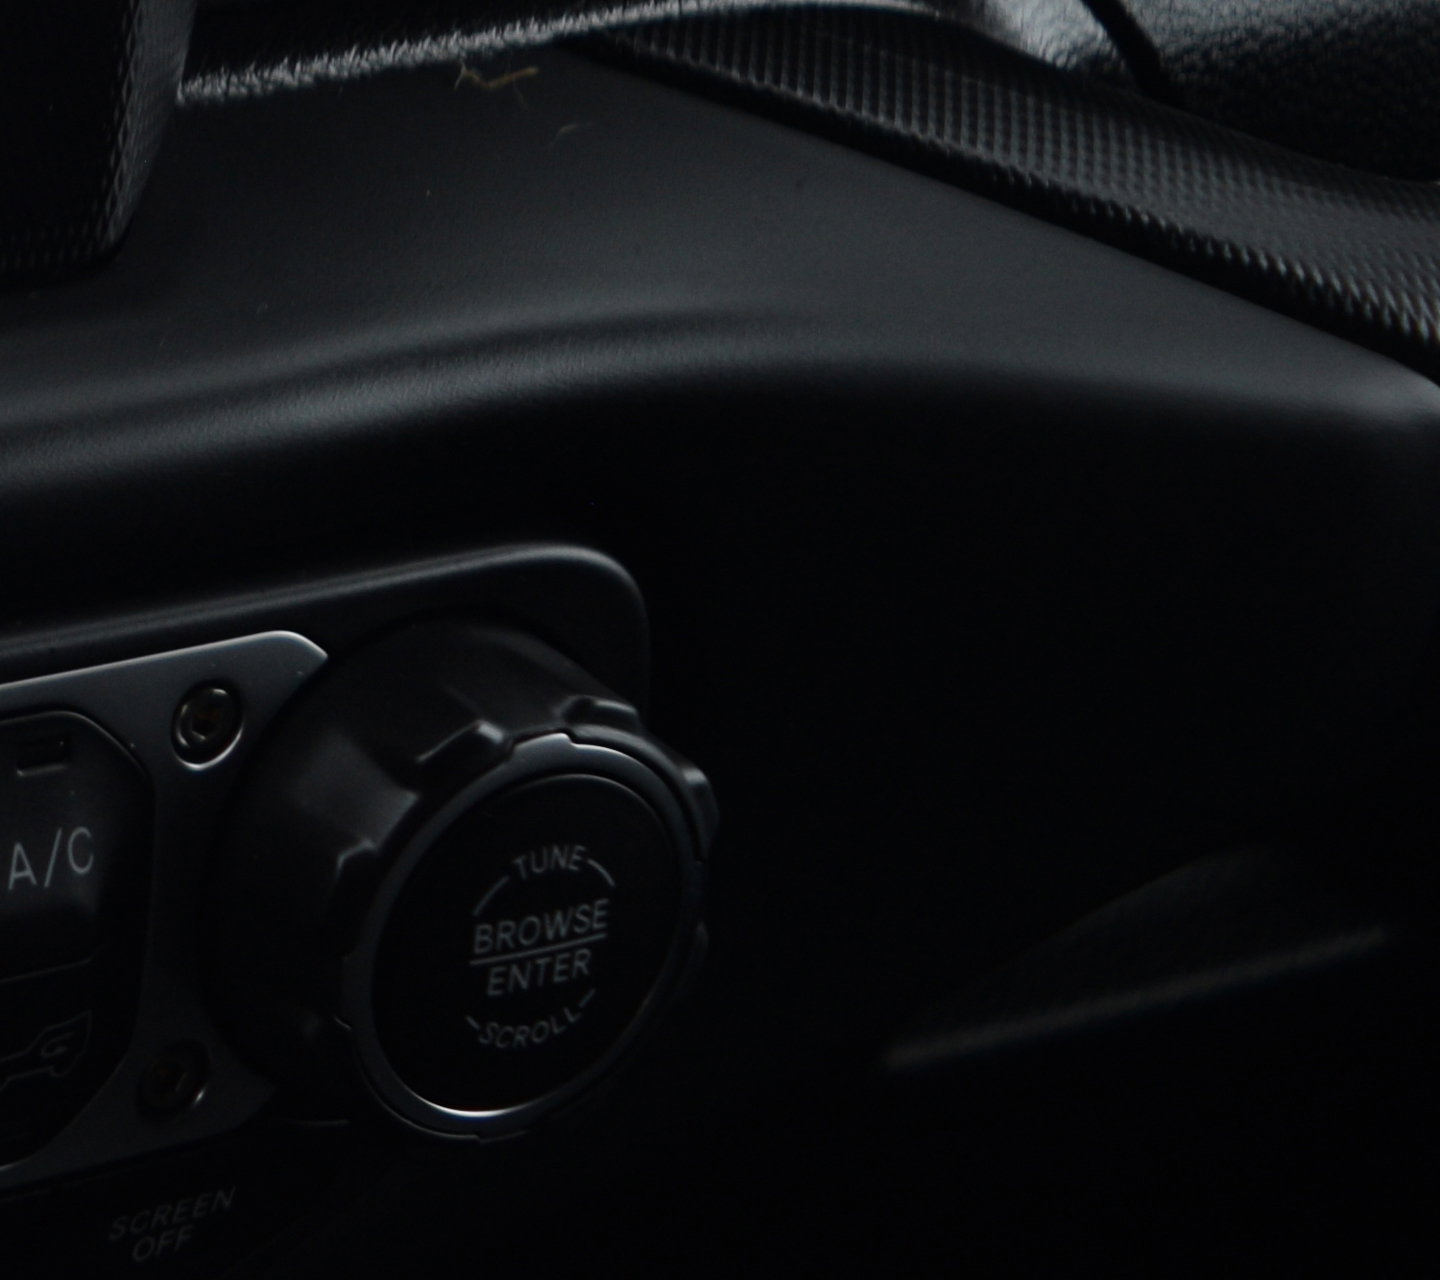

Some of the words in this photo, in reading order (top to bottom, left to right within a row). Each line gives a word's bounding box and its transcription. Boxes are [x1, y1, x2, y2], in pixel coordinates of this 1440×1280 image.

[6, 825, 95, 892] A/C
[512, 843, 588, 882] TUNE
[471, 896, 611, 956] BROWSE
[485, 947, 594, 998] ENTER
[476, 1006, 582, 1050] SCROLL
[107, 1183, 238, 1242] SCREEN
[130, 1222, 196, 1264] OFF
